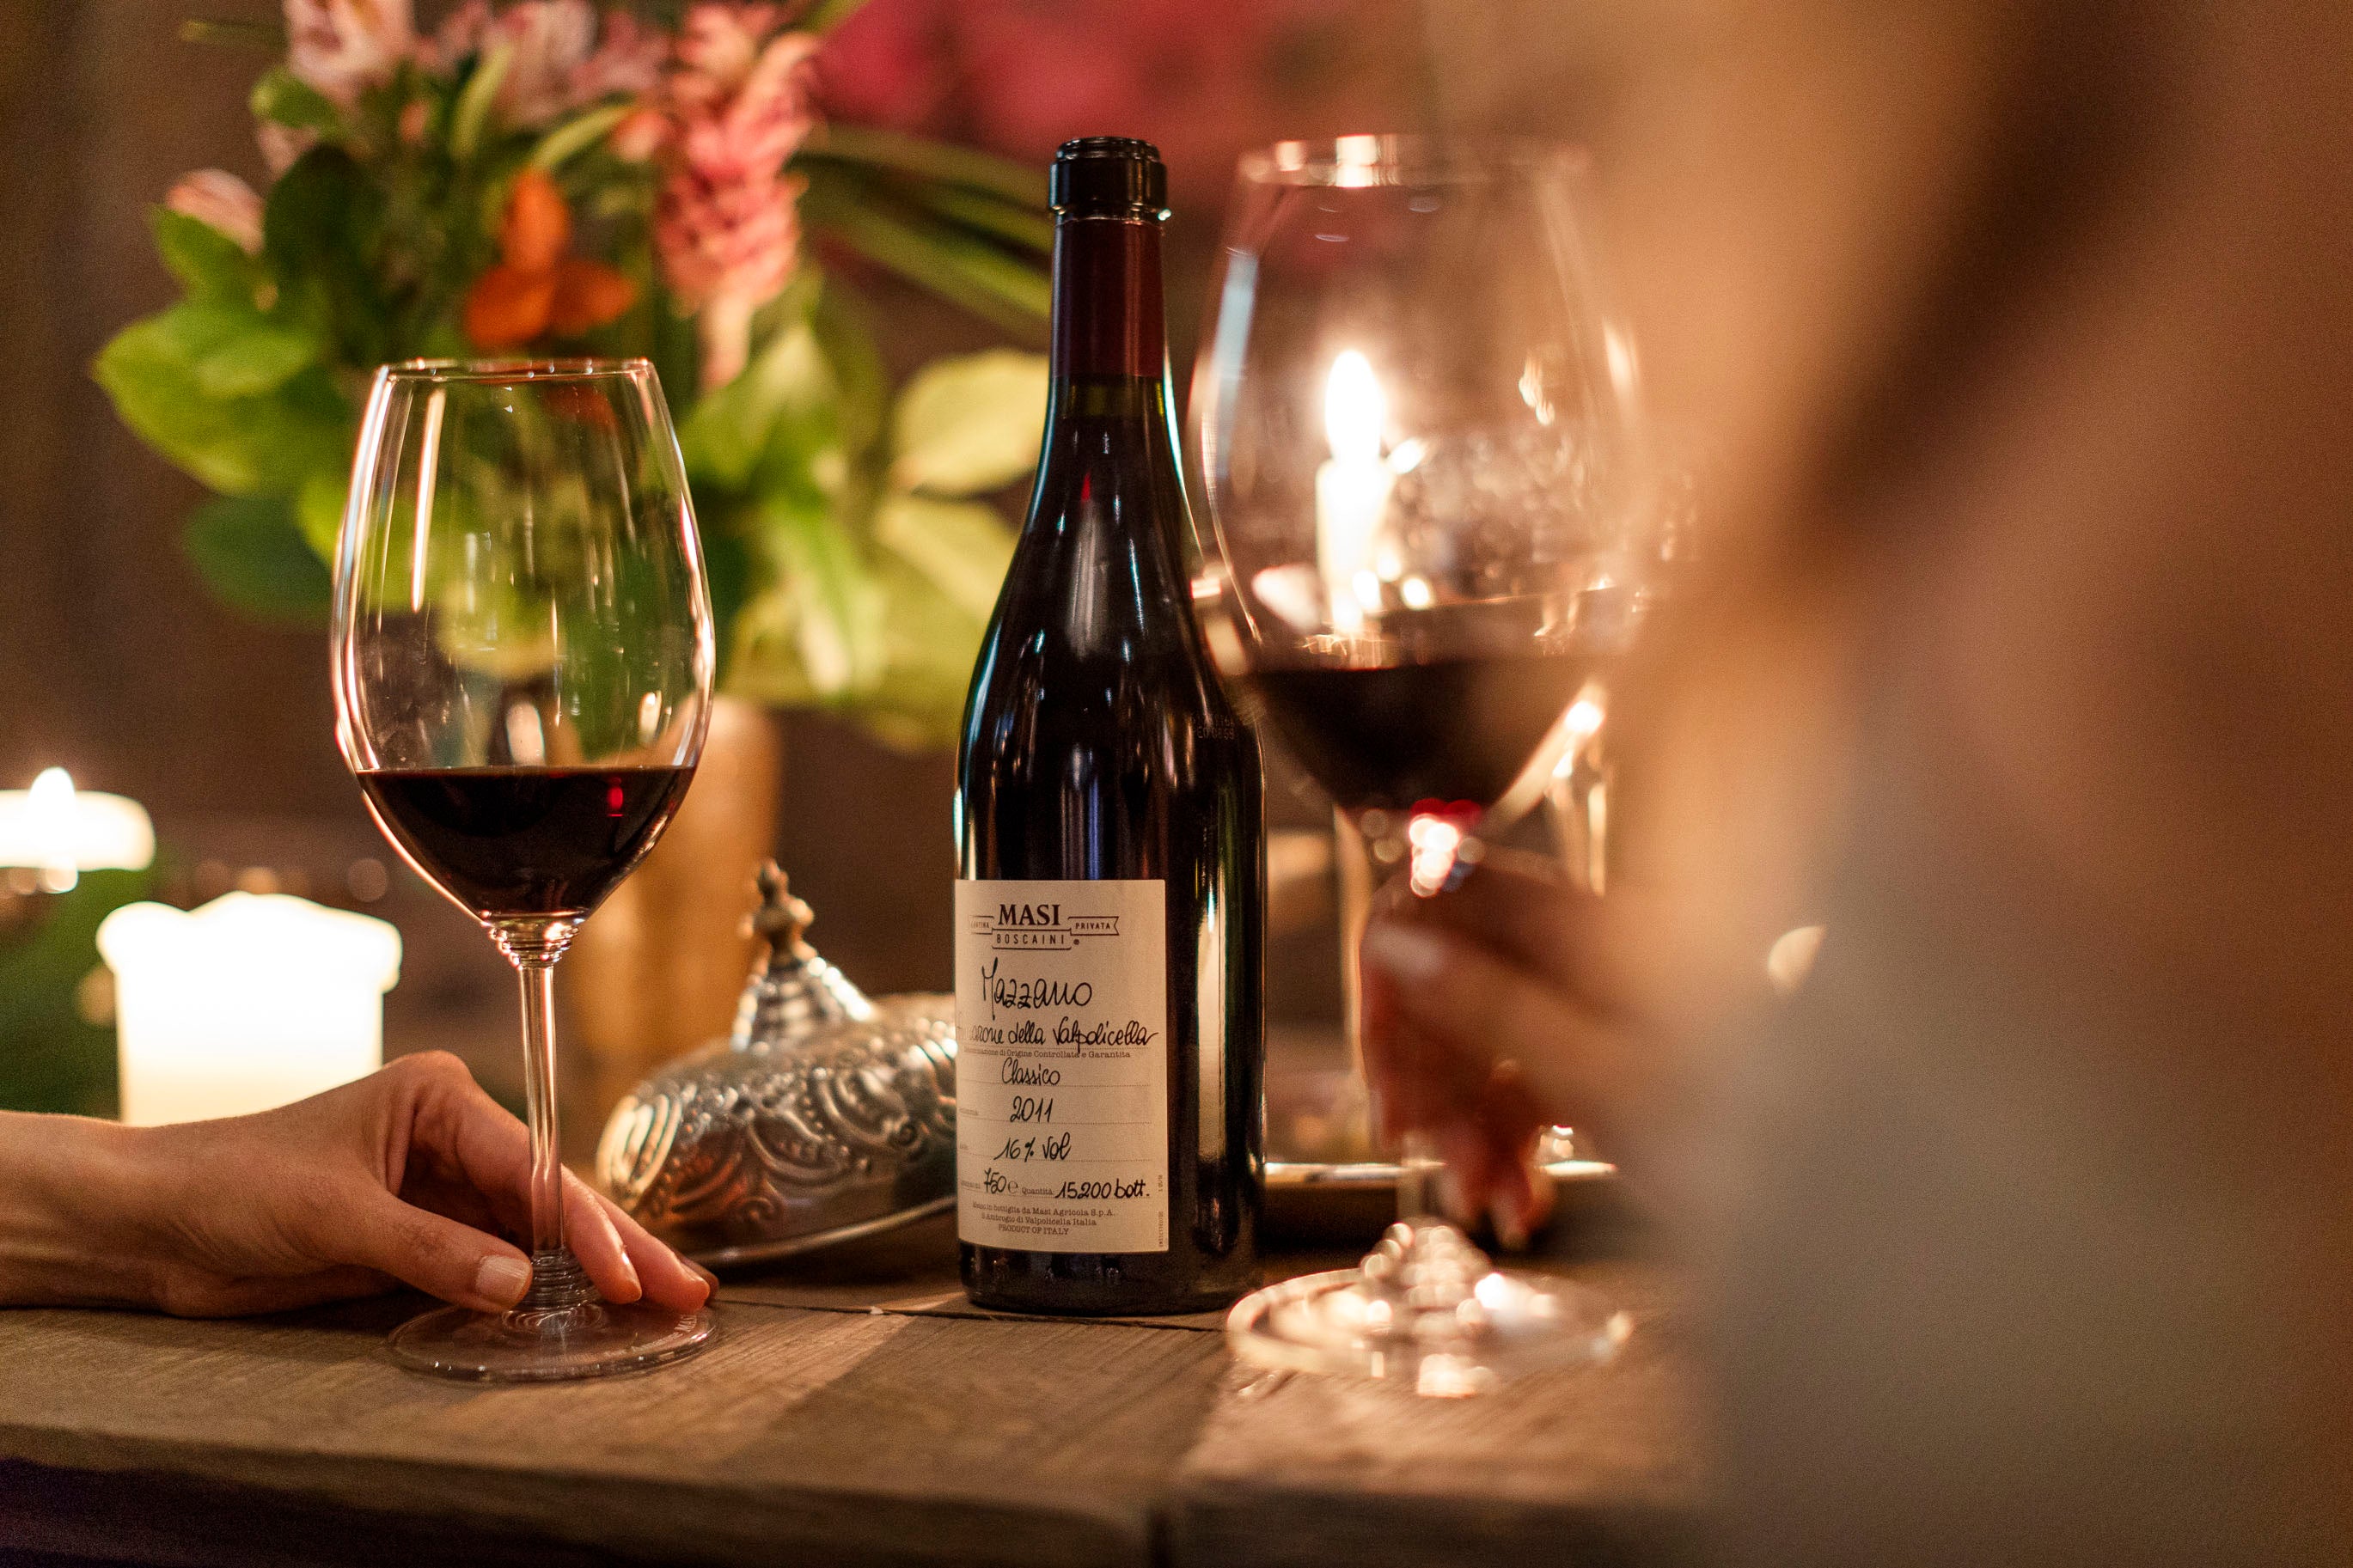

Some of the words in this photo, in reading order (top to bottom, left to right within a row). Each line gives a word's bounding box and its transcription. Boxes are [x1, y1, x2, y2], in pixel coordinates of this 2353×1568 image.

[998, 904, 1060, 926] MASI
[1075, 922, 1111, 930] PRIVATA
[996, 934, 1065, 944] BOSCAINI
[981, 956, 1092, 1021] Mazzano
[1008, 1020, 1046, 1046] della
[1053, 1016, 1159, 1053] Valpolicella
[1006, 1049, 1032, 1058] Origine
[1034, 1050, 1079, 1059] Controllata
[1088, 1050, 1131, 1059] Garantita
[1001, 1057, 1060, 1086] Classico
[1010, 1095, 1054, 1123] 2011
[983, 1168, 1007, 1194] 750
[1025, 1216, 1071, 1225] Valpolicella
[1053, 1208, 1089, 1217] Agricola
[998, 1223, 1030, 1234] PRODUCT
[1031, 1226, 1042, 1235] OF
[1043, 1227, 1069, 1235] ITALY
